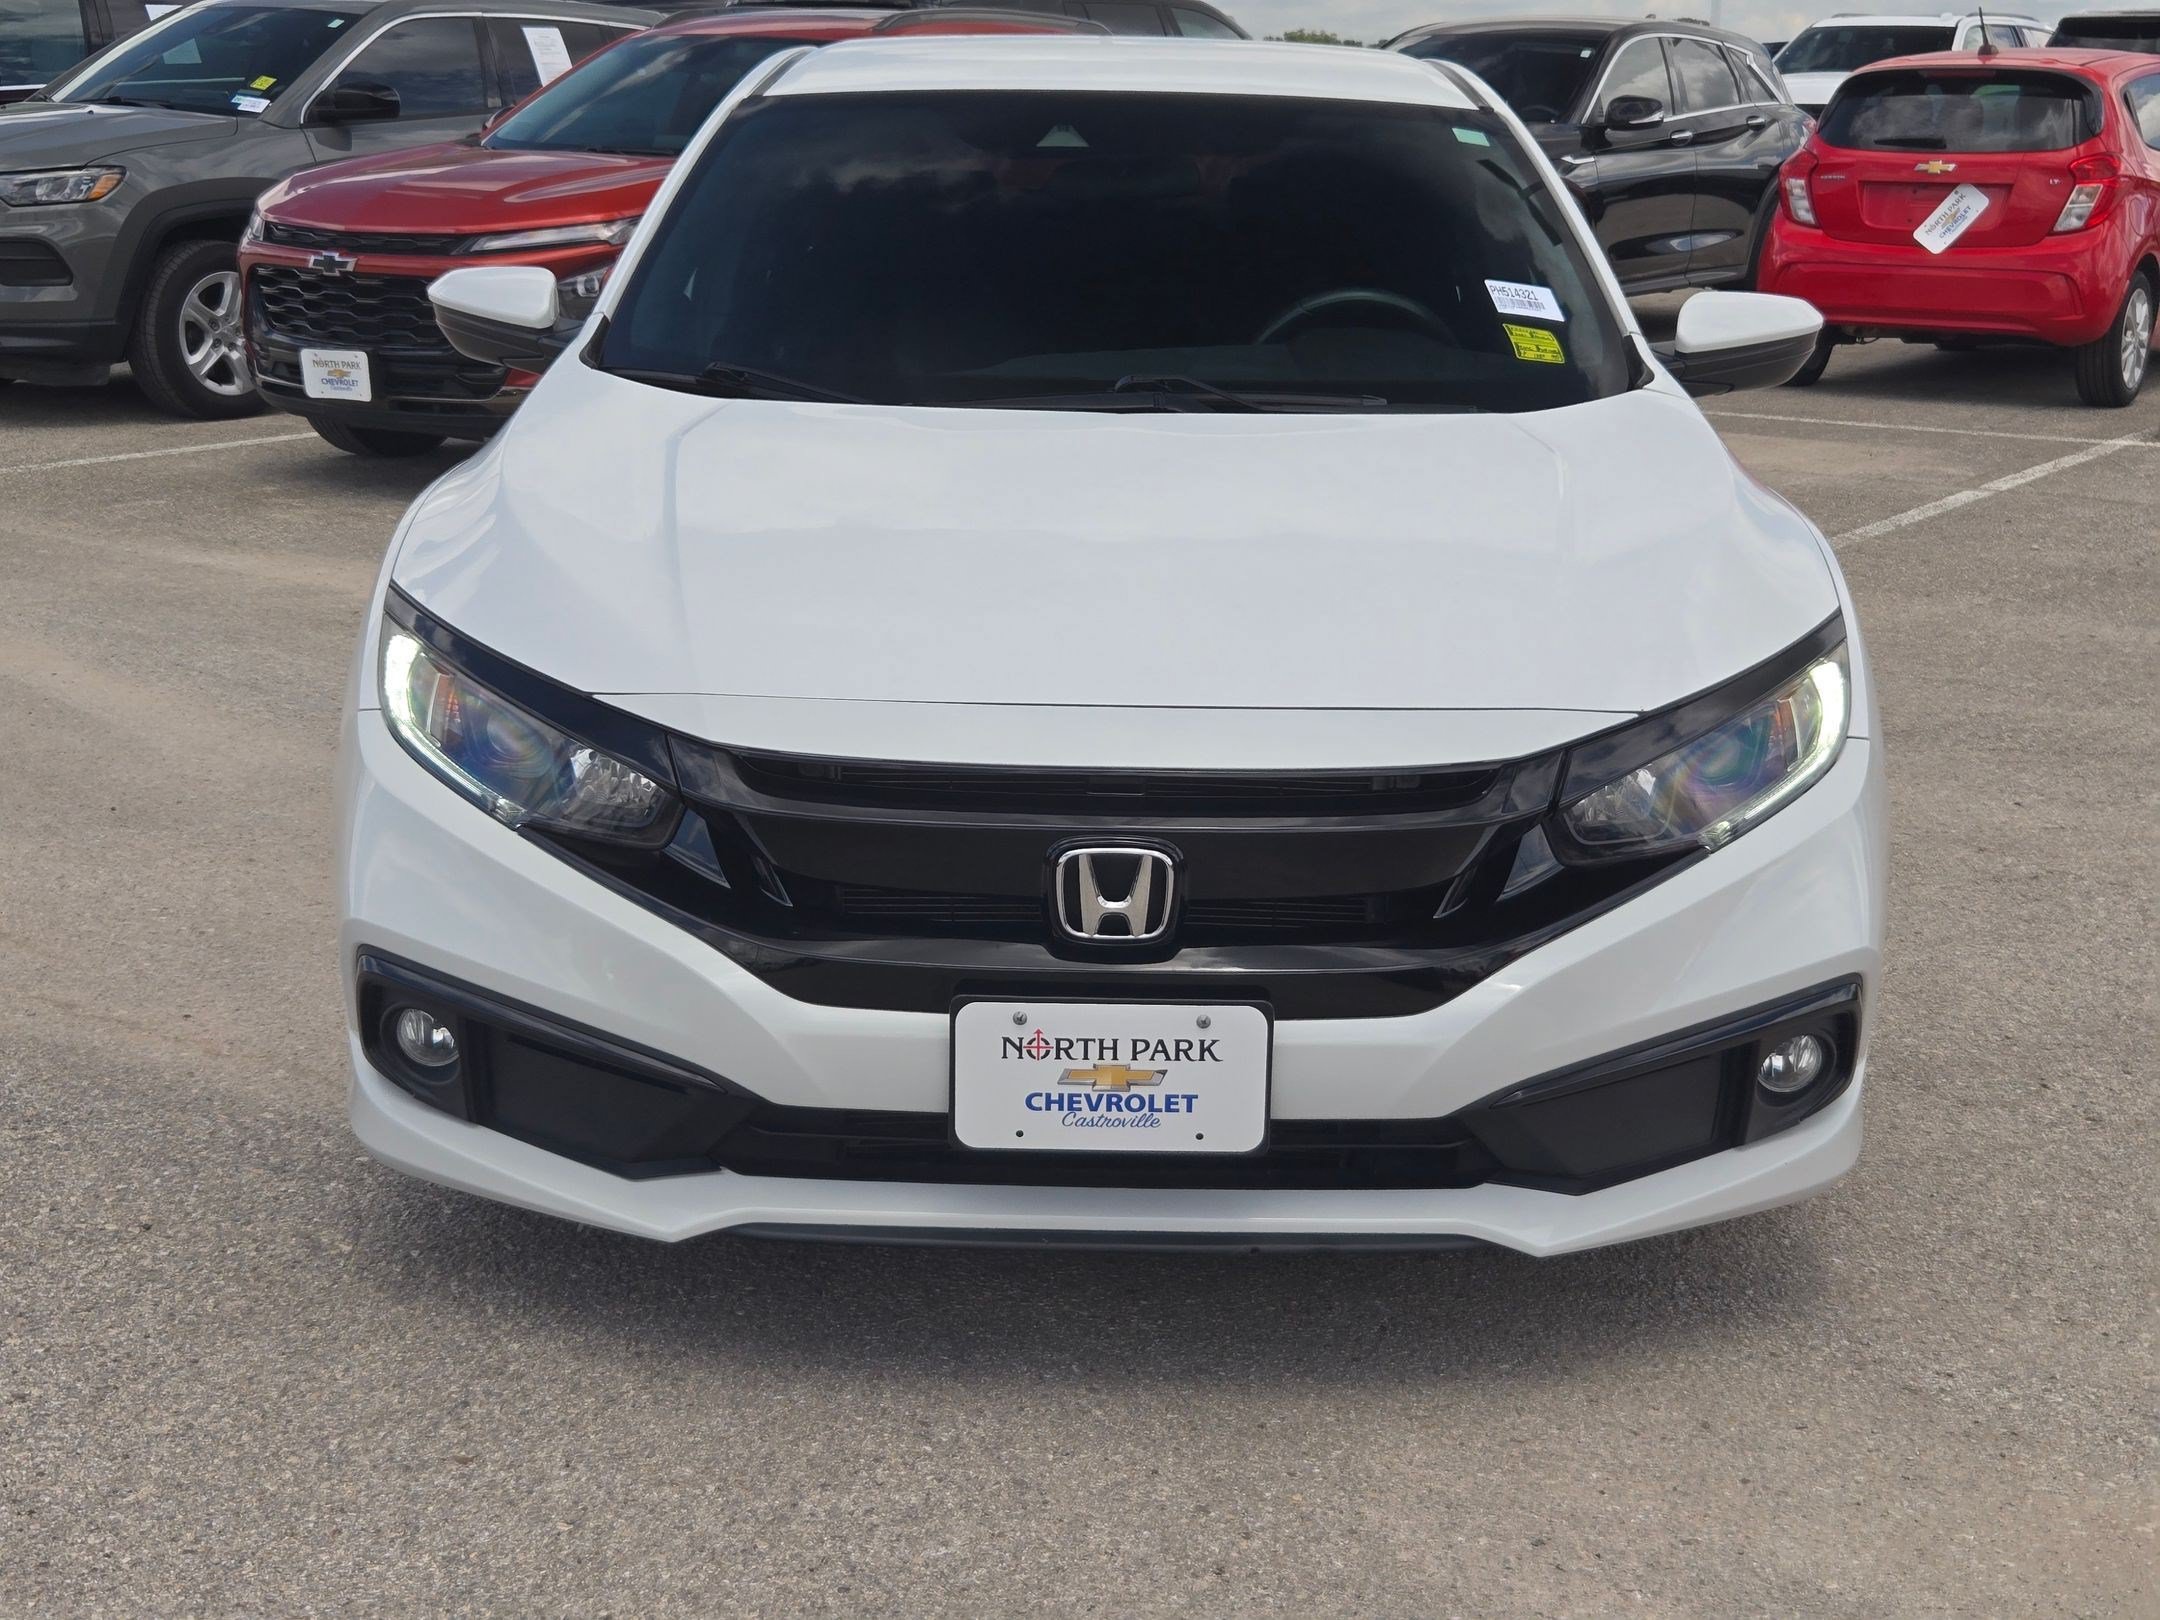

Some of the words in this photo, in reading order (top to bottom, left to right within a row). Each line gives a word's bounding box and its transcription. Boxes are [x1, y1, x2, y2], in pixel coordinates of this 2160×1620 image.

[1925, 213, 1949, 236] NORTH
[1947, 192, 1966, 213] PARK
[1939, 204, 1972, 239] CHEVROLET
[1489, 285, 1538, 300] PH514321
[312, 359, 340, 369] NORTH
[341, 361, 361, 370] PARK
[321, 378, 359, 387] CHEVROLET
[1001, 1034, 1119, 1061] NORTH
[1130, 1038, 1223, 1062] PARK
[1025, 1092, 1199, 1113] CHEVROLET
[1061, 1111, 1162, 1128] Castroville
